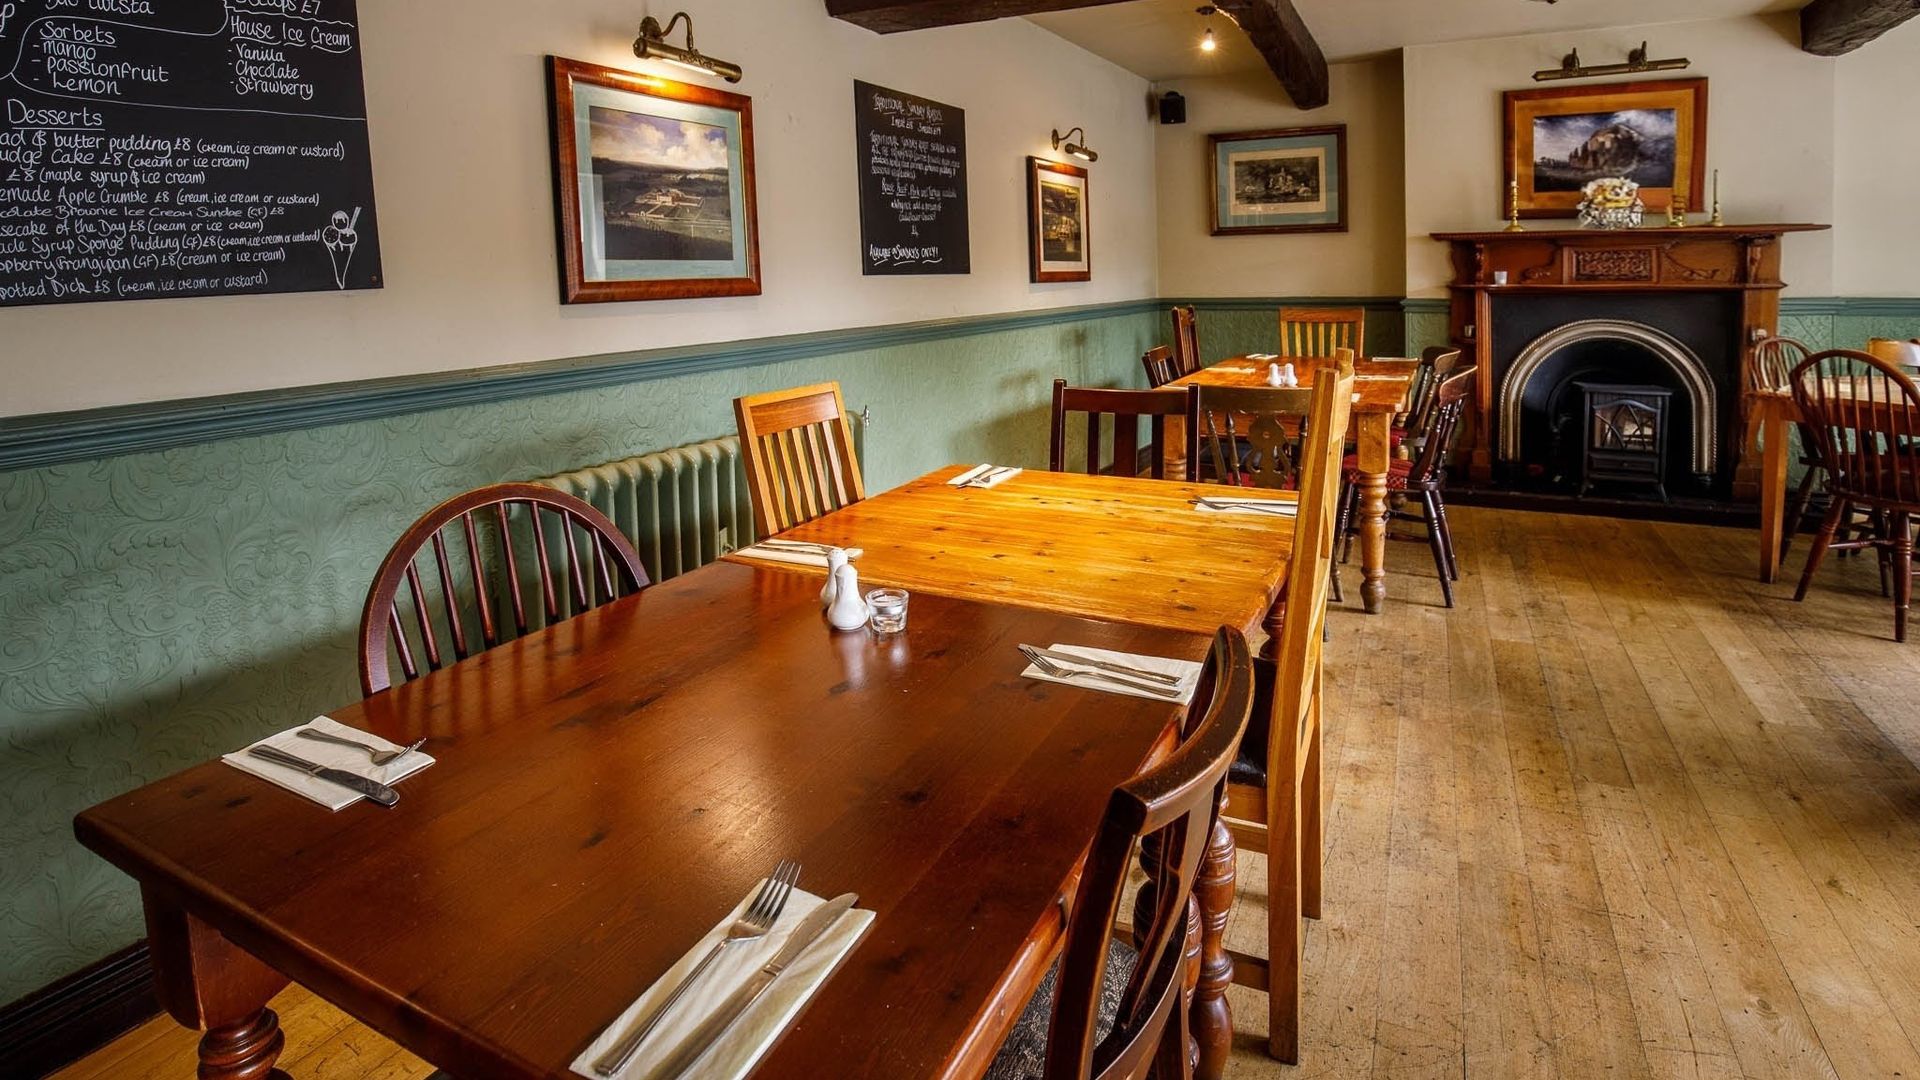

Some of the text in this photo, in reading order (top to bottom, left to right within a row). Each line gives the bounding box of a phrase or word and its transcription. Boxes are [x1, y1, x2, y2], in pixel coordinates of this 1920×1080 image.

[40, 21, 116, 45] Sorbets
[231, 15, 350, 46] House Ice Cream
[44, 40, 96, 66] mango
[236, 43, 285, 62] Vanilla
[47, 56, 169, 82] passionfruit
[235, 60, 299, 80] Chocolate
[53, 72, 121, 95] Lemon
[235, 76, 314, 100] Strawberry
[8, 98, 103, 126] Desserts
[54, 132, 104, 149] butter
[109, 134, 172, 159] pudding
[174, 137, 191, 151] £8
[253, 145, 286, 155] cream
[286, 146, 300, 155] or
[0, 146, 42, 171] udge
[51, 148, 95, 165] Cake
[100, 152, 124, 166] £8
[176, 158, 190, 167] or
[193, 155, 209, 168] ice
[211, 155, 250, 170] cream)
[39, 167, 83, 185] (maple
[90, 171, 128, 188] syrup
[142, 171, 161, 184] ice
[165, 171, 206, 185] cream)
[58, 186, 96, 206] Apple
[100, 189, 149, 203] Crumble
[153, 190, 170, 203] £8
[229, 193, 259, 204] cream
[263, 195, 274, 204] or
[55, 205, 118, 220] Brownie
[124, 207, 145, 216] Ice
[149, 207, 193, 217] Cream
[196, 207, 243, 218] Sundae
[269, 207, 284, 216] £8
[55, 219, 70, 236] of
[74, 219, 97, 234] the
[98, 219, 126, 239] Day
[129, 219, 145, 232] £8
[191, 223, 203, 231] or
[206, 220, 223, 231] ice
[32, 236, 75, 259] Syrup
[77, 235, 124, 256] Sponge
[130, 234, 180, 255] Pudding
[57, 256, 131, 277] Frangipan
[161, 254, 176, 267] £8
[220, 254, 231, 262] or
[236, 250, 251, 263] ice
[51, 277, 91, 297] Dick
[95, 280, 111, 293] £8
[160, 279, 175, 291] ice
[178, 278, 209, 290] cream
[210, 277, 220, 288] or
